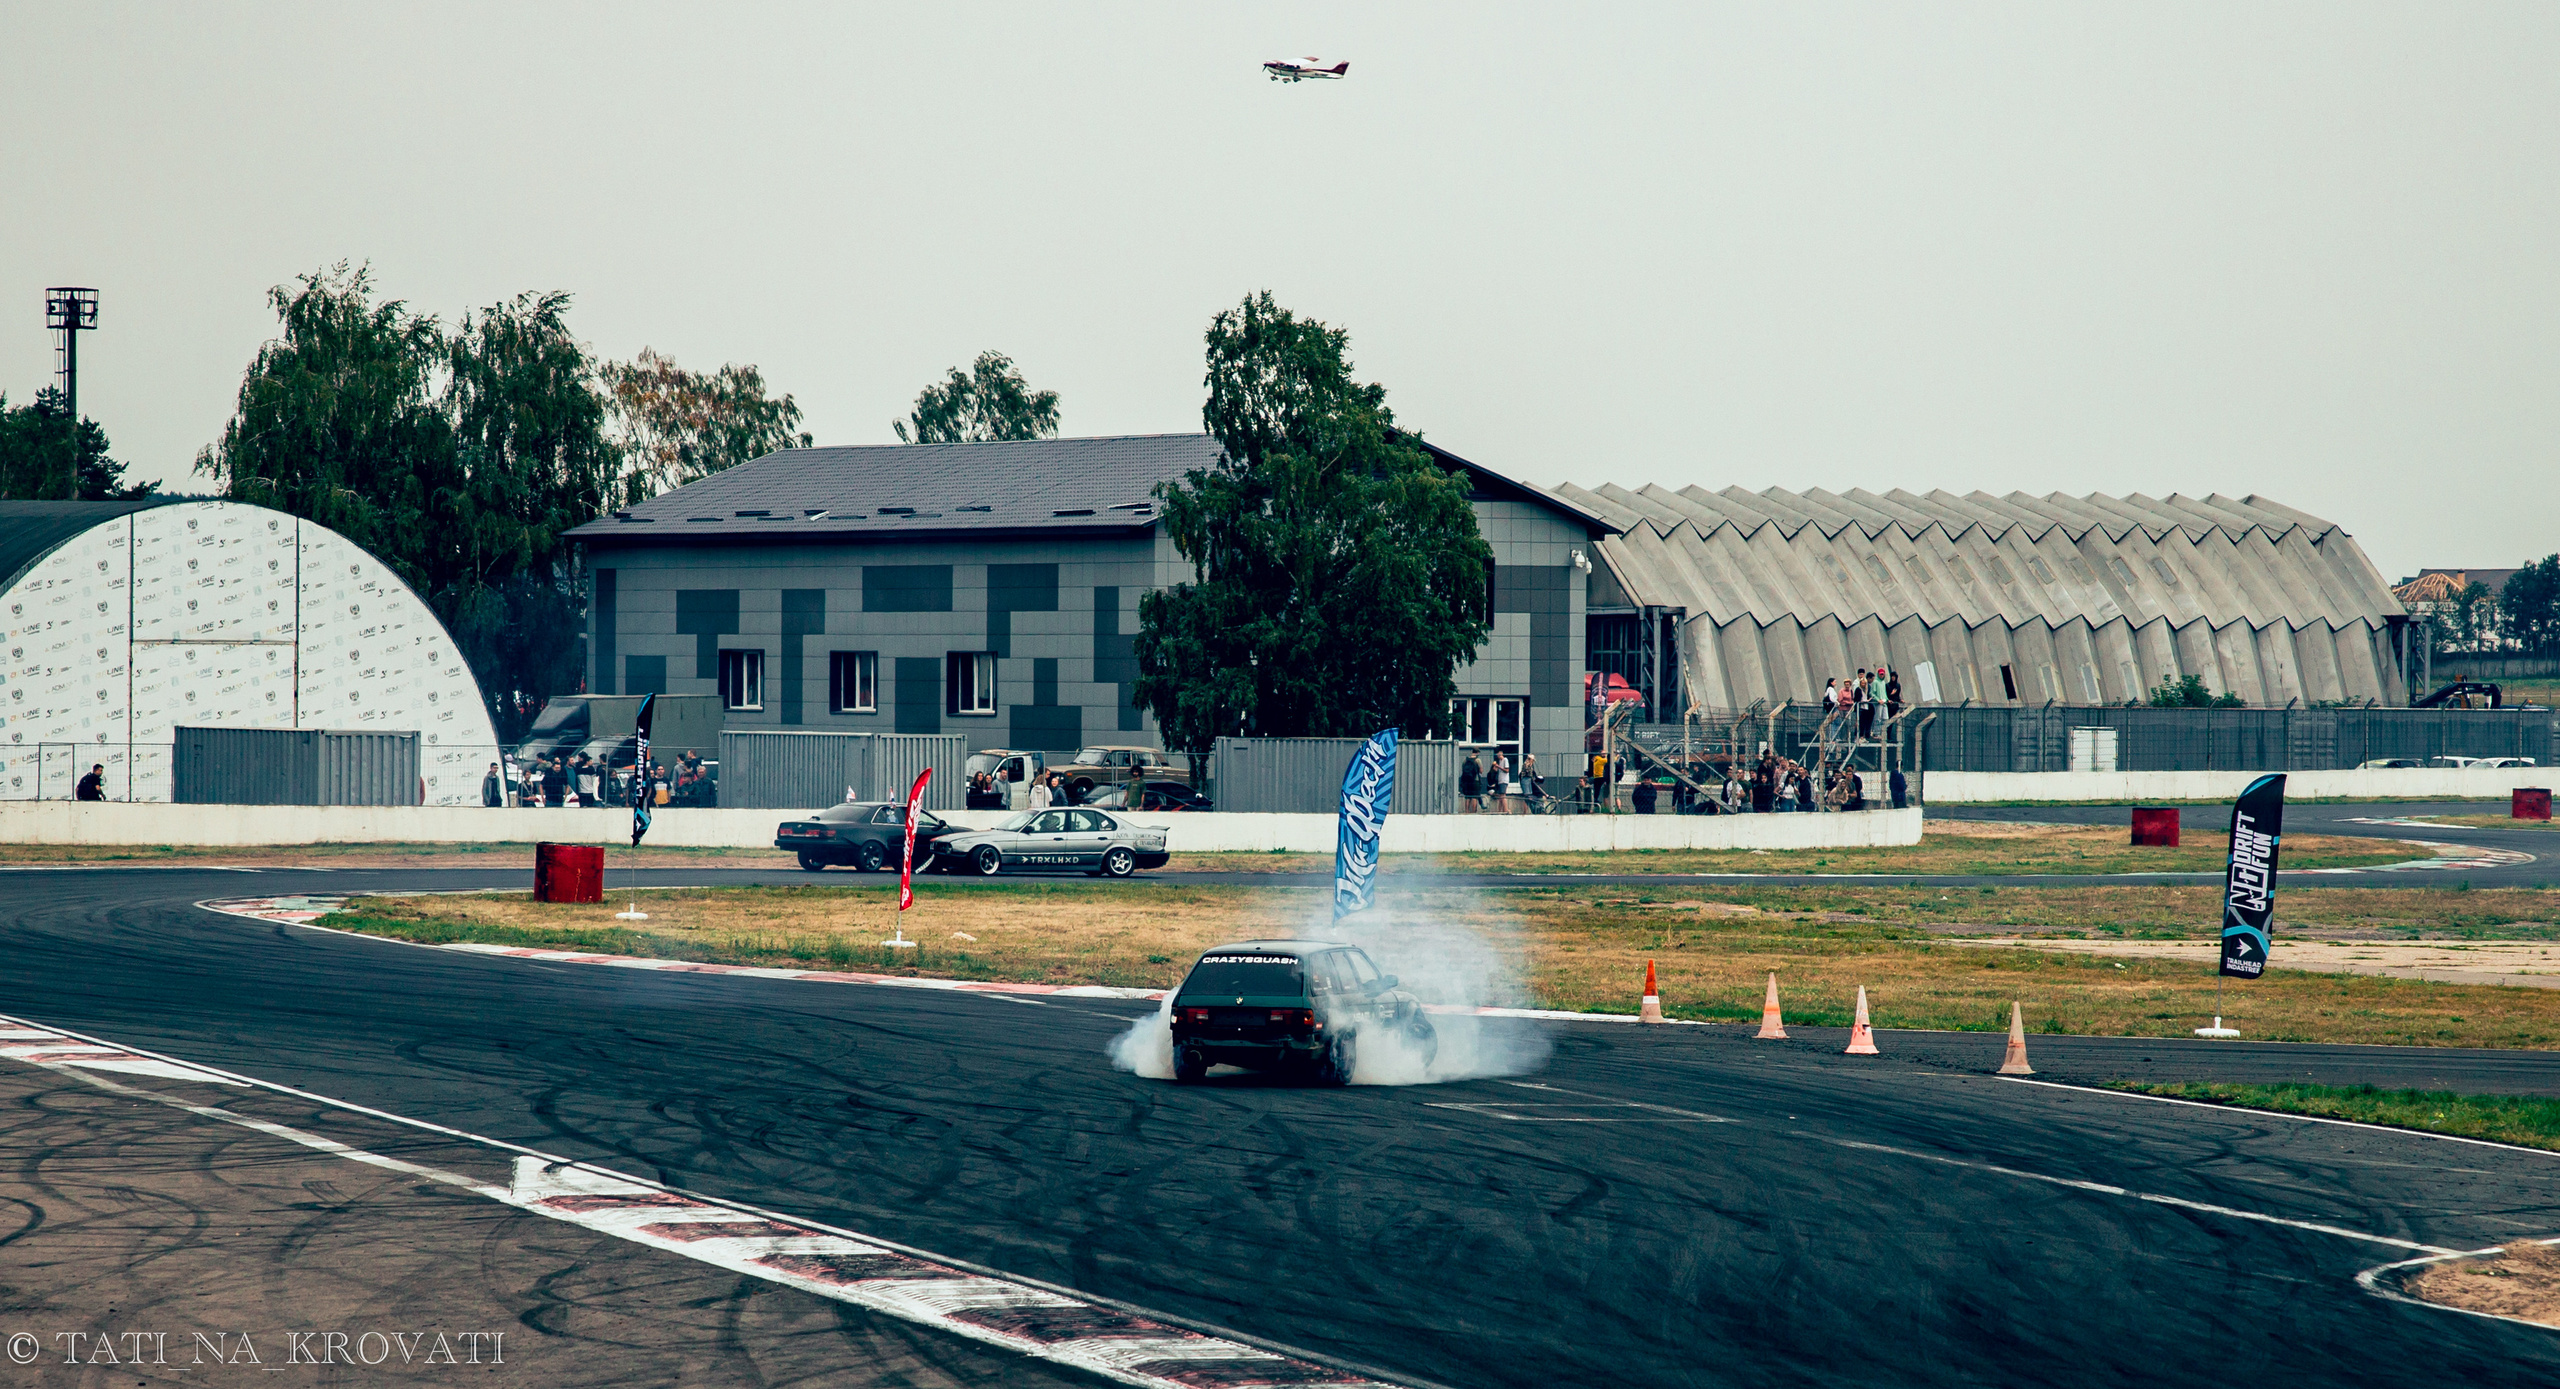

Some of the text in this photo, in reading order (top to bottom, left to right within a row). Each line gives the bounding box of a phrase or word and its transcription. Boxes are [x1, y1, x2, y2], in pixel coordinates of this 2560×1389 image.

[2233, 810, 2255, 862] DRIFT
[2251, 832, 2272, 869] FUN
[1202, 956, 1298, 964] CRAZYSQUASH
